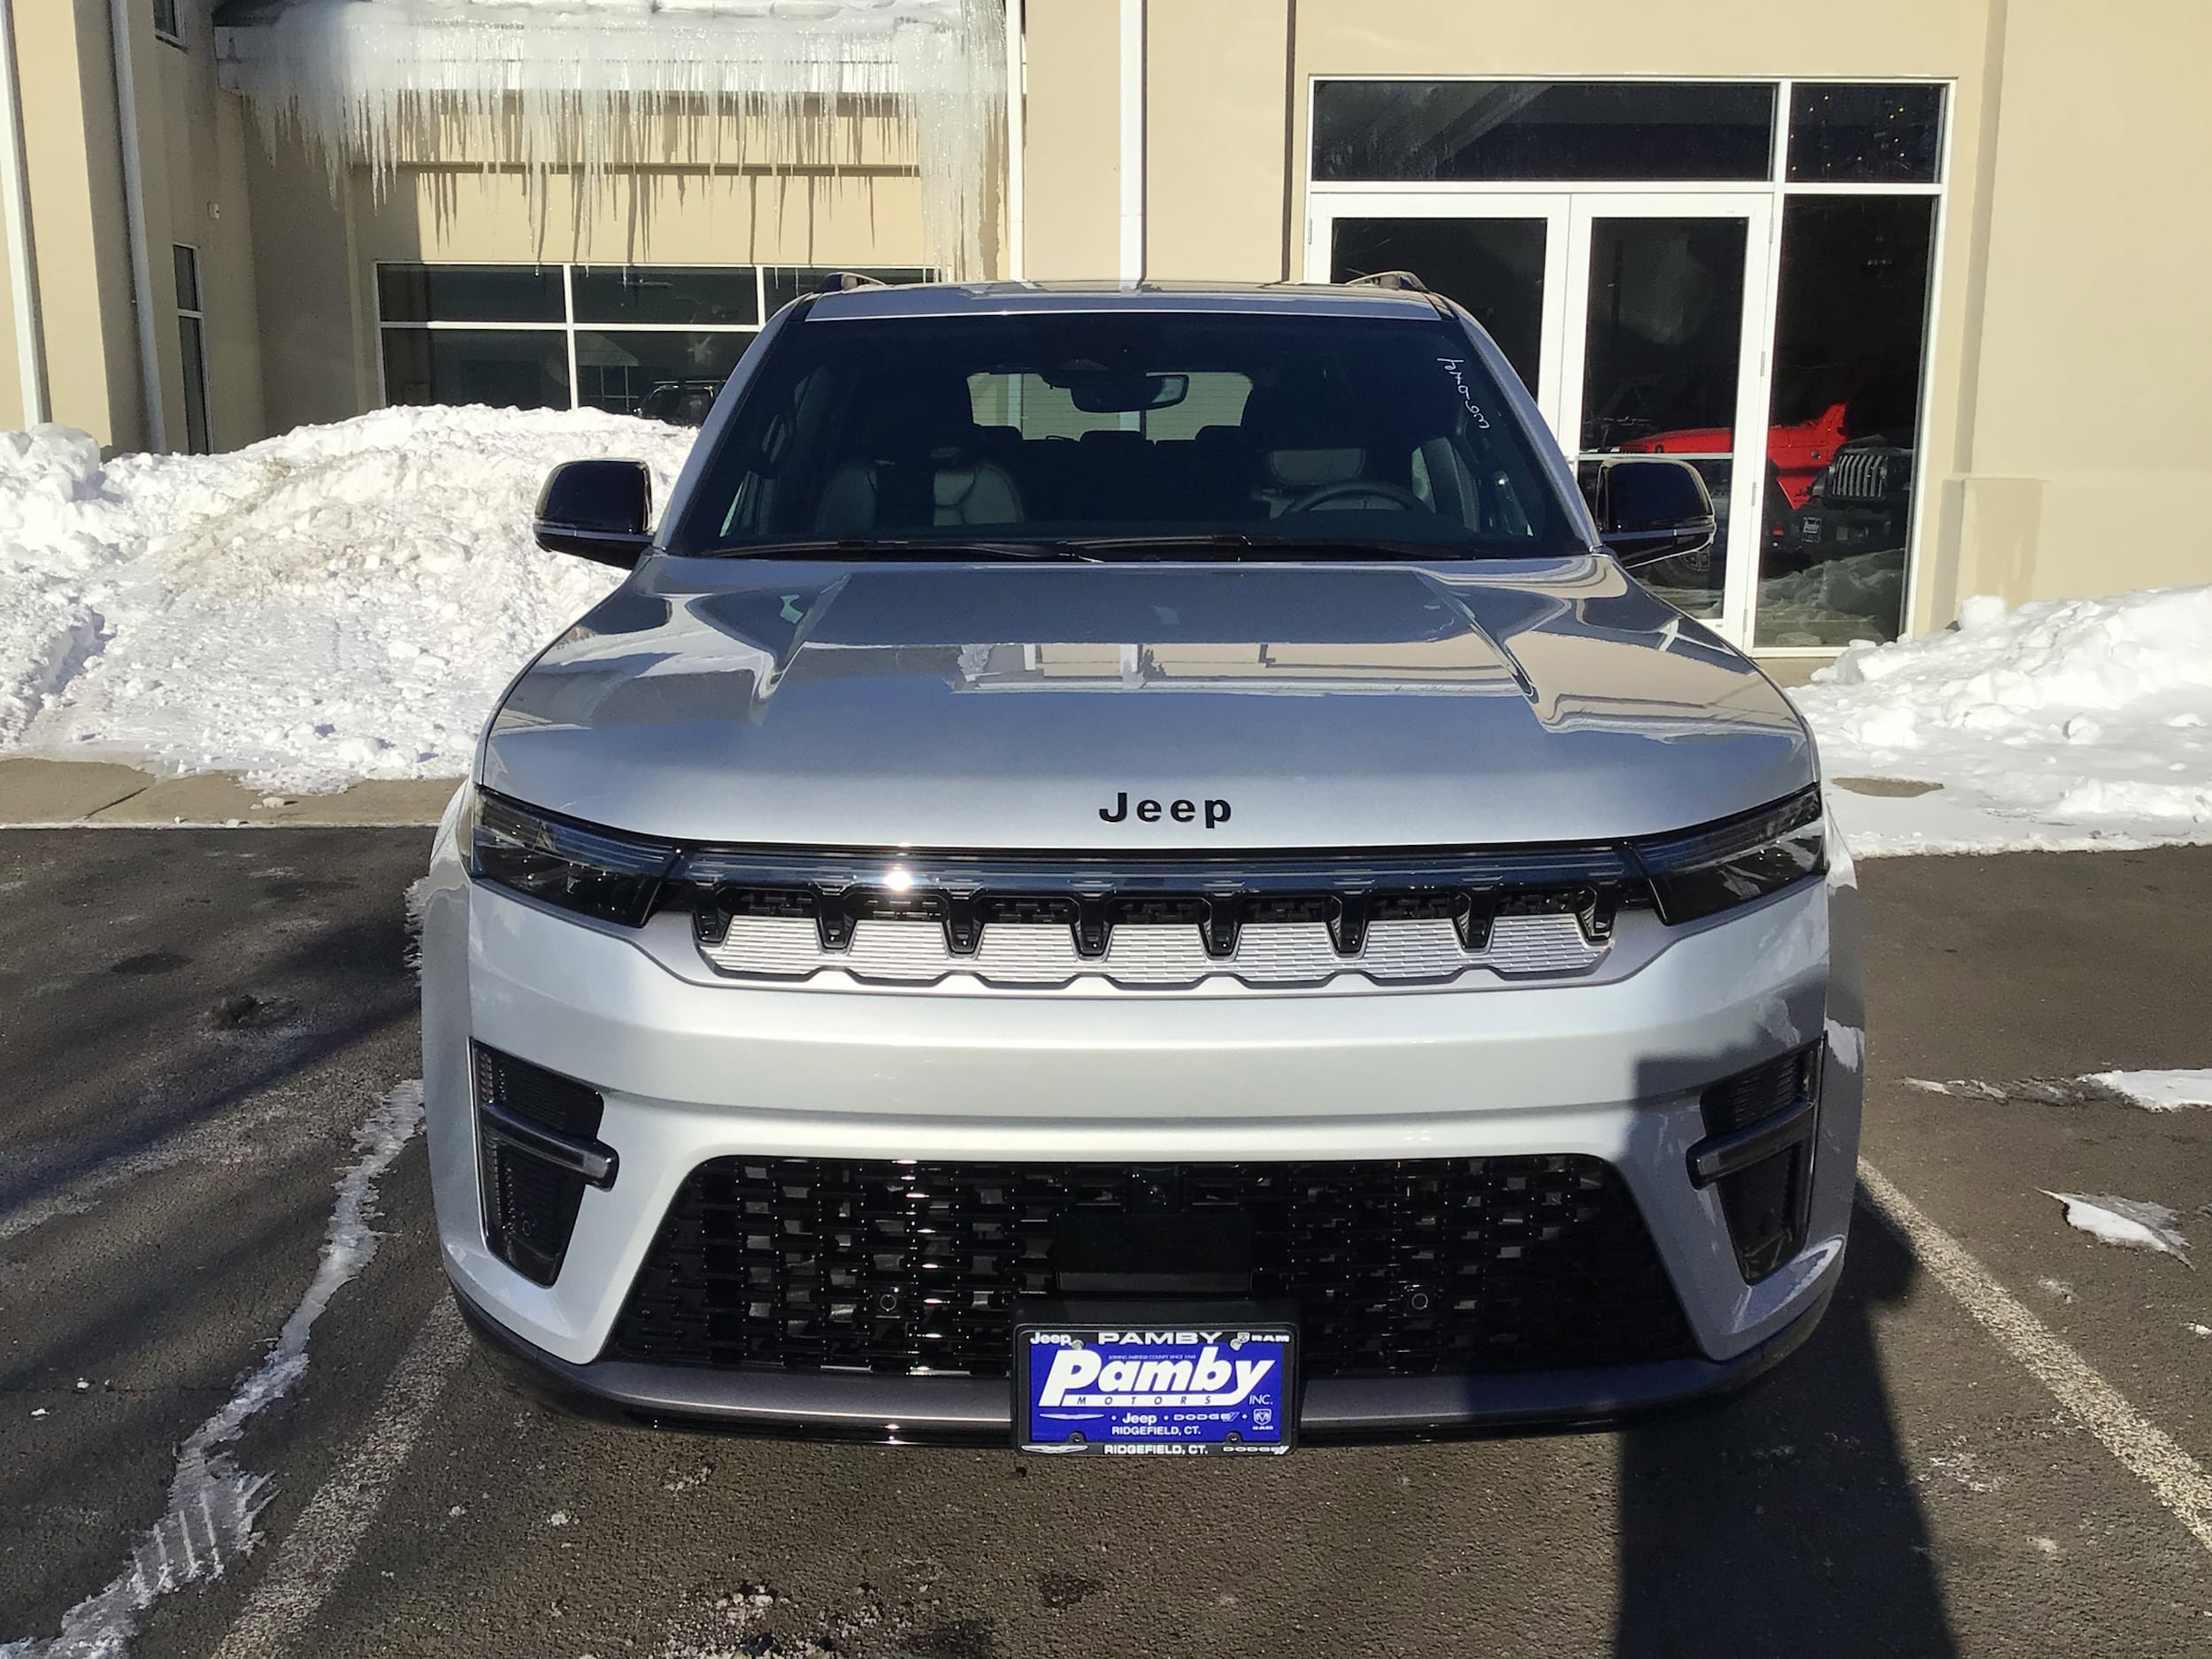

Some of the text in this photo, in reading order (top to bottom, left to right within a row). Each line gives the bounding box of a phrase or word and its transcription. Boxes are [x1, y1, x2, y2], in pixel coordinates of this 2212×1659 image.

[1098, 792, 1232, 829] Jeep
[1030, 1333, 1072, 1346] Jeep
[1097, 1333, 1223, 1345] PAMBY
[1251, 1334, 1290, 1343] RAM
[1038, 1347, 1276, 1407] Pamby
[1077, 1396, 1211, 1405] MOTORS
[1248, 1394, 1273, 1405] INC.
[1121, 1412, 1157, 1425] Jeep
[1111, 1425, 1202, 1436] RIDGEFIELD, CT.
[1103, 1445, 1209, 1455] RIDGEFIELD, CT.
